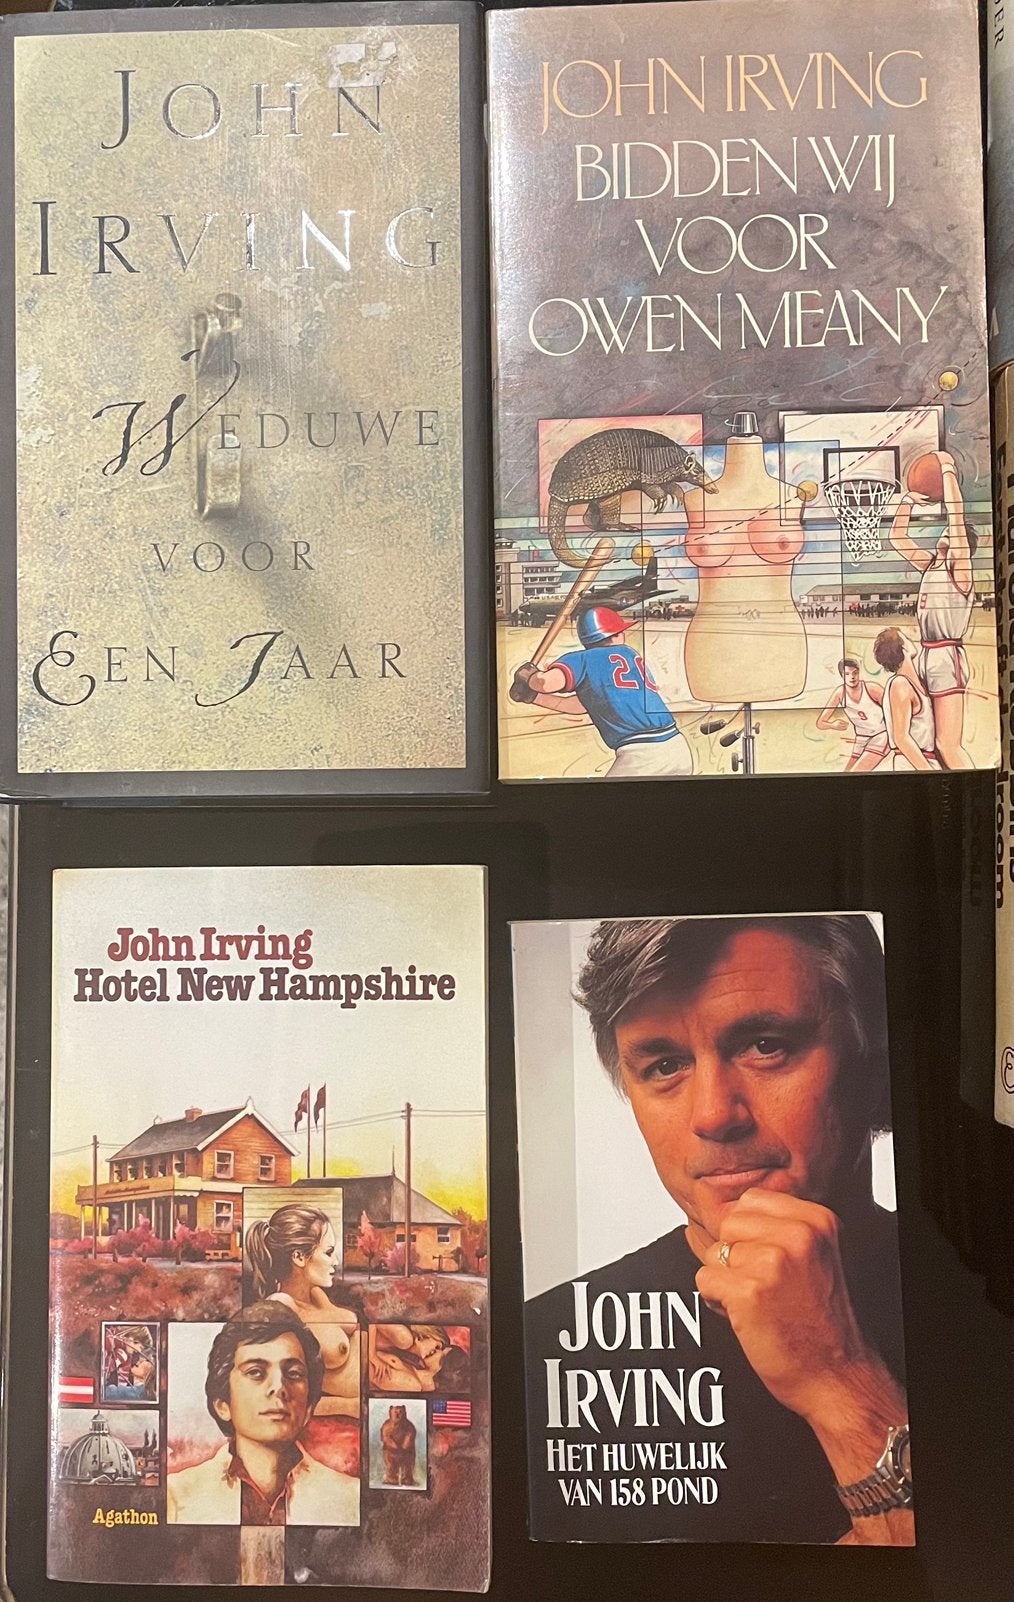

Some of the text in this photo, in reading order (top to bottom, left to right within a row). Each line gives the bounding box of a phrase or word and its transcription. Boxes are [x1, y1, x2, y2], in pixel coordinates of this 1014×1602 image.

[101, 70, 382, 150] JOHN
[540, 50, 928, 135] JOHN IRVING
[575, 134, 896, 207] BIDDEN WIJ
[32, 201, 441, 275] IRVING
[635, 213, 837, 276] VOOR
[528, 285, 948, 356] OWEN MEANY
[92, 350, 440, 476] WEDUWE
[151, 541, 315, 573] VOOR
[33, 630, 407, 707] EEN JAAR
[107, 925, 313, 969] John Irving
[73, 965, 456, 1009] Hotel New Hampshire
[558, 1281, 701, 1352] JOHN
[544, 1358, 726, 1433] IRVING
[546, 1439, 727, 1472] HET HUWELIJK
[558, 1476, 719, 1506] VAN 158 POND
[92, 1508, 158, 1527] Agathon
